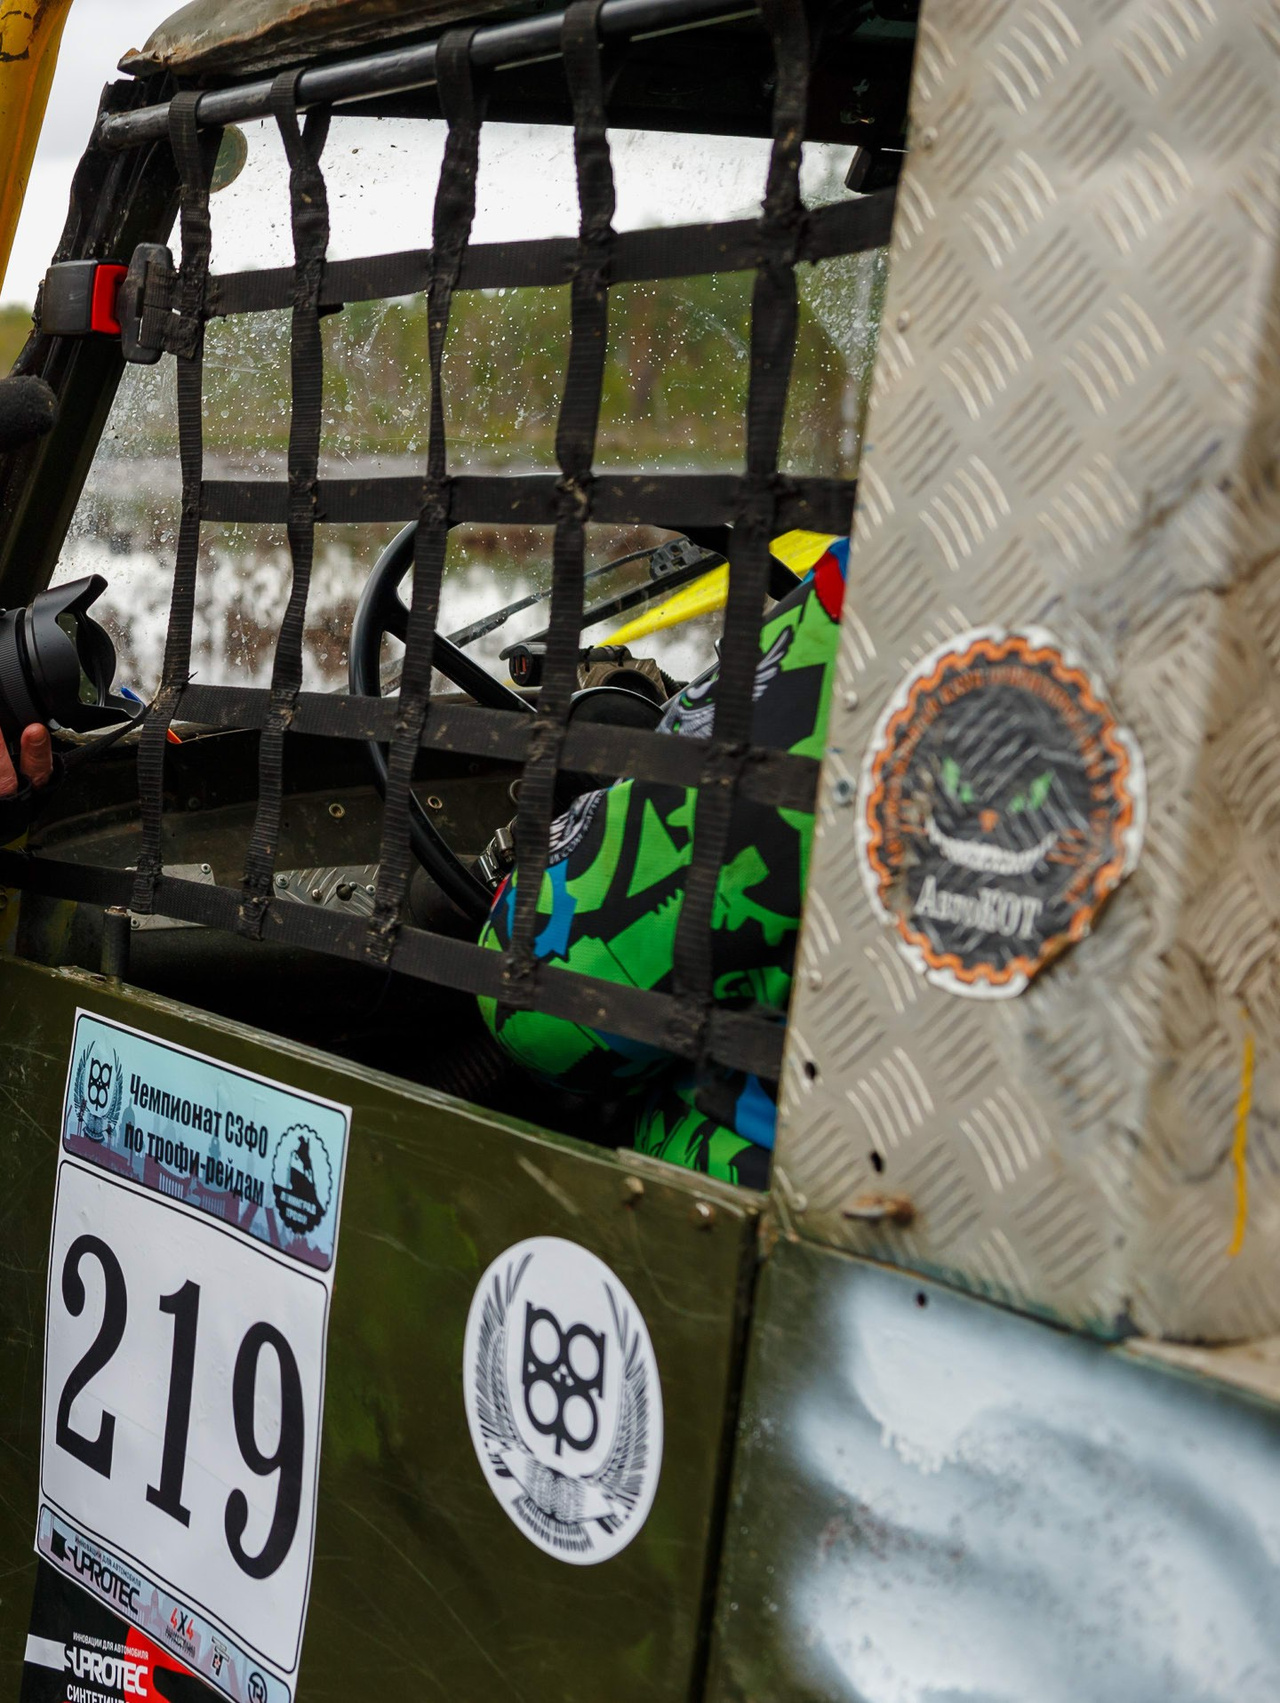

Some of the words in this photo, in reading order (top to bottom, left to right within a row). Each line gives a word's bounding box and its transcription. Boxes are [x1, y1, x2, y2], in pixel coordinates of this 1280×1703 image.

[129, 1073, 222, 1138] Чемпионат
[224, 1110, 268, 1159] СЗФО
[123, 1123, 144, 1153] по
[147, 1132, 265, 1207] трофи-рейдам
[55, 1234, 305, 1580] 219
[64, 1545, 140, 1615] SUPROTEC
[64, 1645, 148, 1697] SUPROTEC
[102, 1640, 114, 1651] ДЛЯ
[114, 1643, 149, 1660] АВТОМОБИЛЯ
